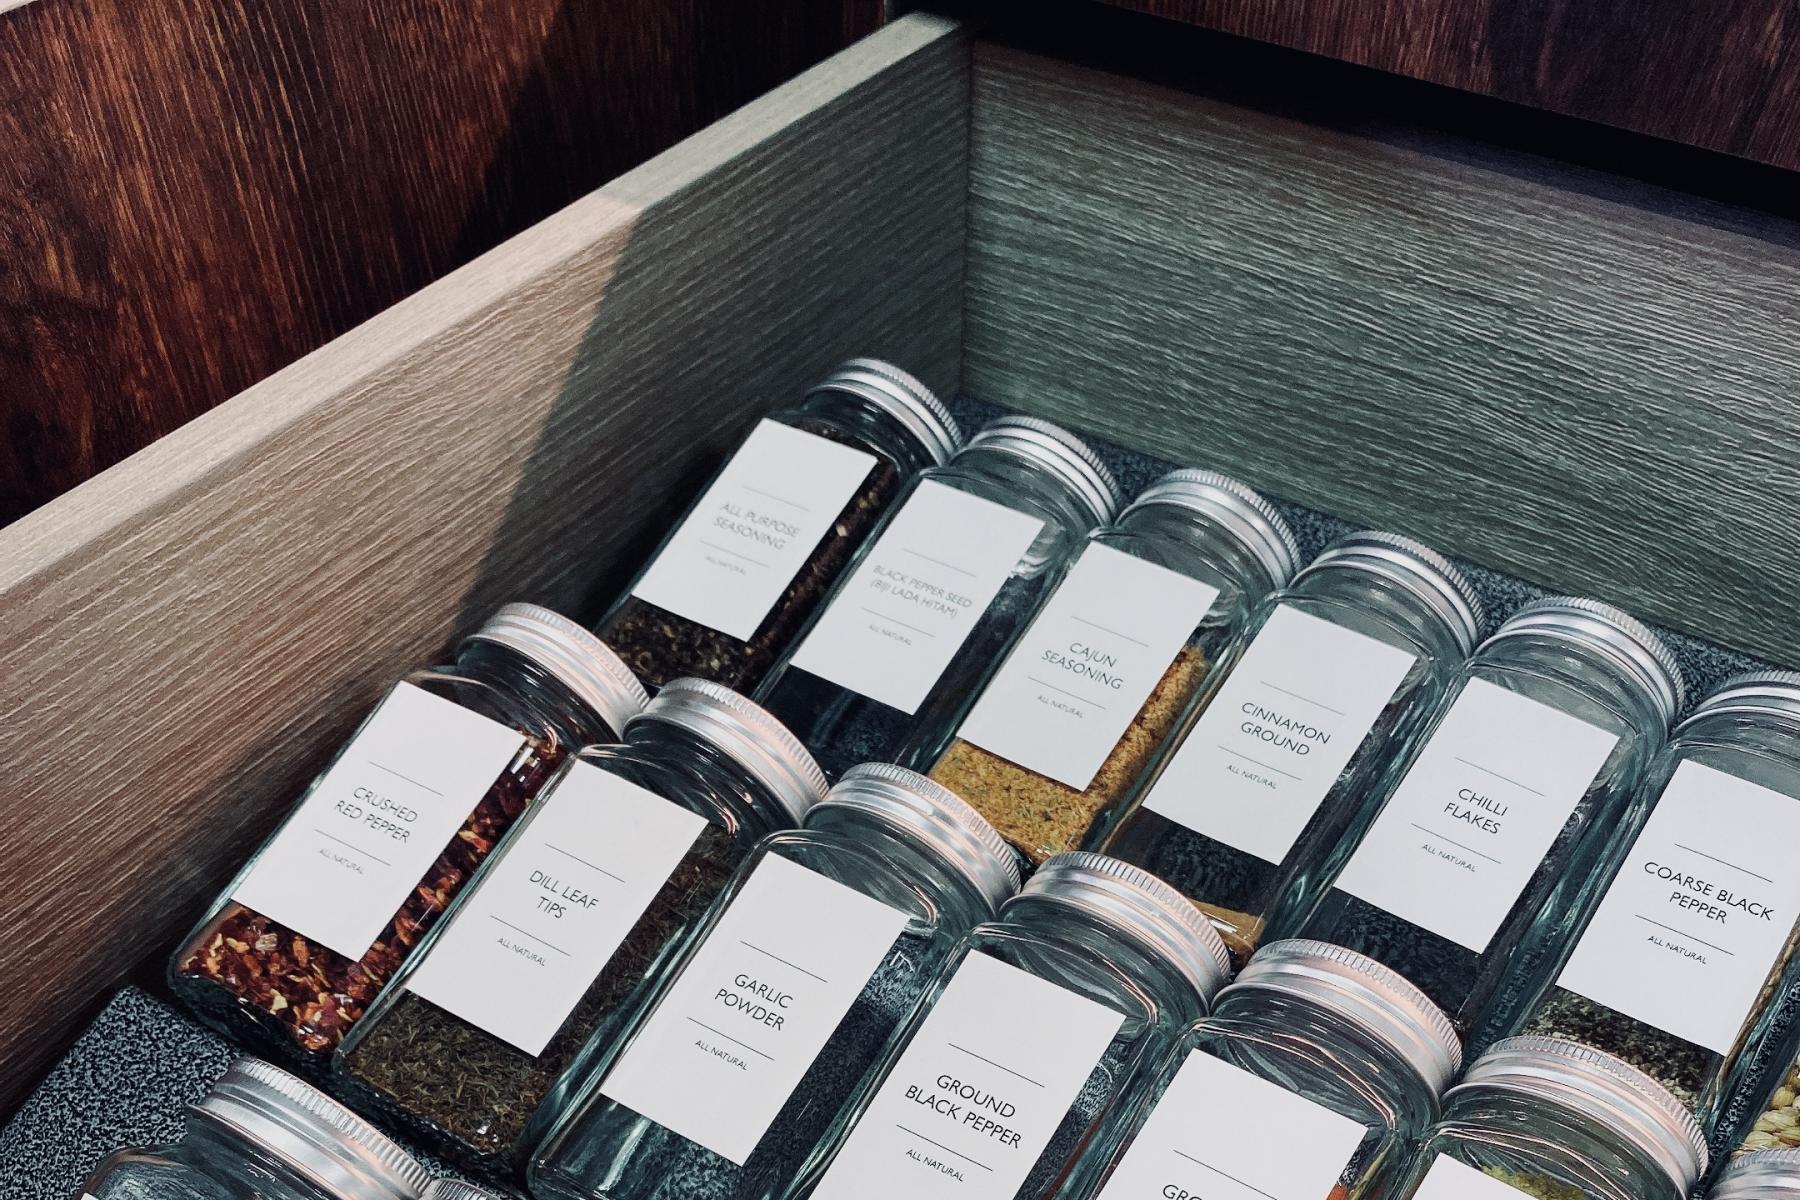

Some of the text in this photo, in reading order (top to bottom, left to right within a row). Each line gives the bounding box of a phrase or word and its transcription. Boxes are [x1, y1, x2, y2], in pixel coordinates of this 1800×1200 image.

[713, 516, 787, 551] SEASONING
[719, 503, 801, 538] ALL PURPOSE
[872, 564, 974, 608] BLACK PEPPER SEED
[890, 585, 920, 604] LADA
[1041, 649, 1124, 690] SEASONING
[1069, 642, 1118, 668] CAJUN
[1036, 694, 1084, 720] ALL NATURAL
[1241, 702, 1332, 745] CINNAMON
[1240, 721, 1310, 756] GROUND
[1224, 764, 1277, 790] ALL NATURAL
[353, 787, 418, 823] CRUSHED
[1443, 802, 1501, 835] FLAKES
[1458, 788, 1509, 817] CHILLI
[334, 799, 411, 844] RED PEPPER
[1421, 843, 1476, 873] ALL NATURAL
[528, 869, 599, 909] DILL LEAF
[1644, 861, 1775, 921] COARSE BLACK
[537, 895, 567, 919] TIPS
[1669, 891, 1727, 925] PEPPER
[496, 937, 548, 968] ALL NATURAL
[1647, 935, 1707, 965] ALL NATURAL
[734, 974, 794, 1009] GARLIC
[714, 988, 785, 1032] POWDER
[694, 1040, 747, 1071] ALL NATURAL
[936, 1074, 1016, 1118] GROUND
[904, 1084, 1022, 1150] BLACK PEPPER
[905, 1149, 964, 1183] ALL NATURAL
